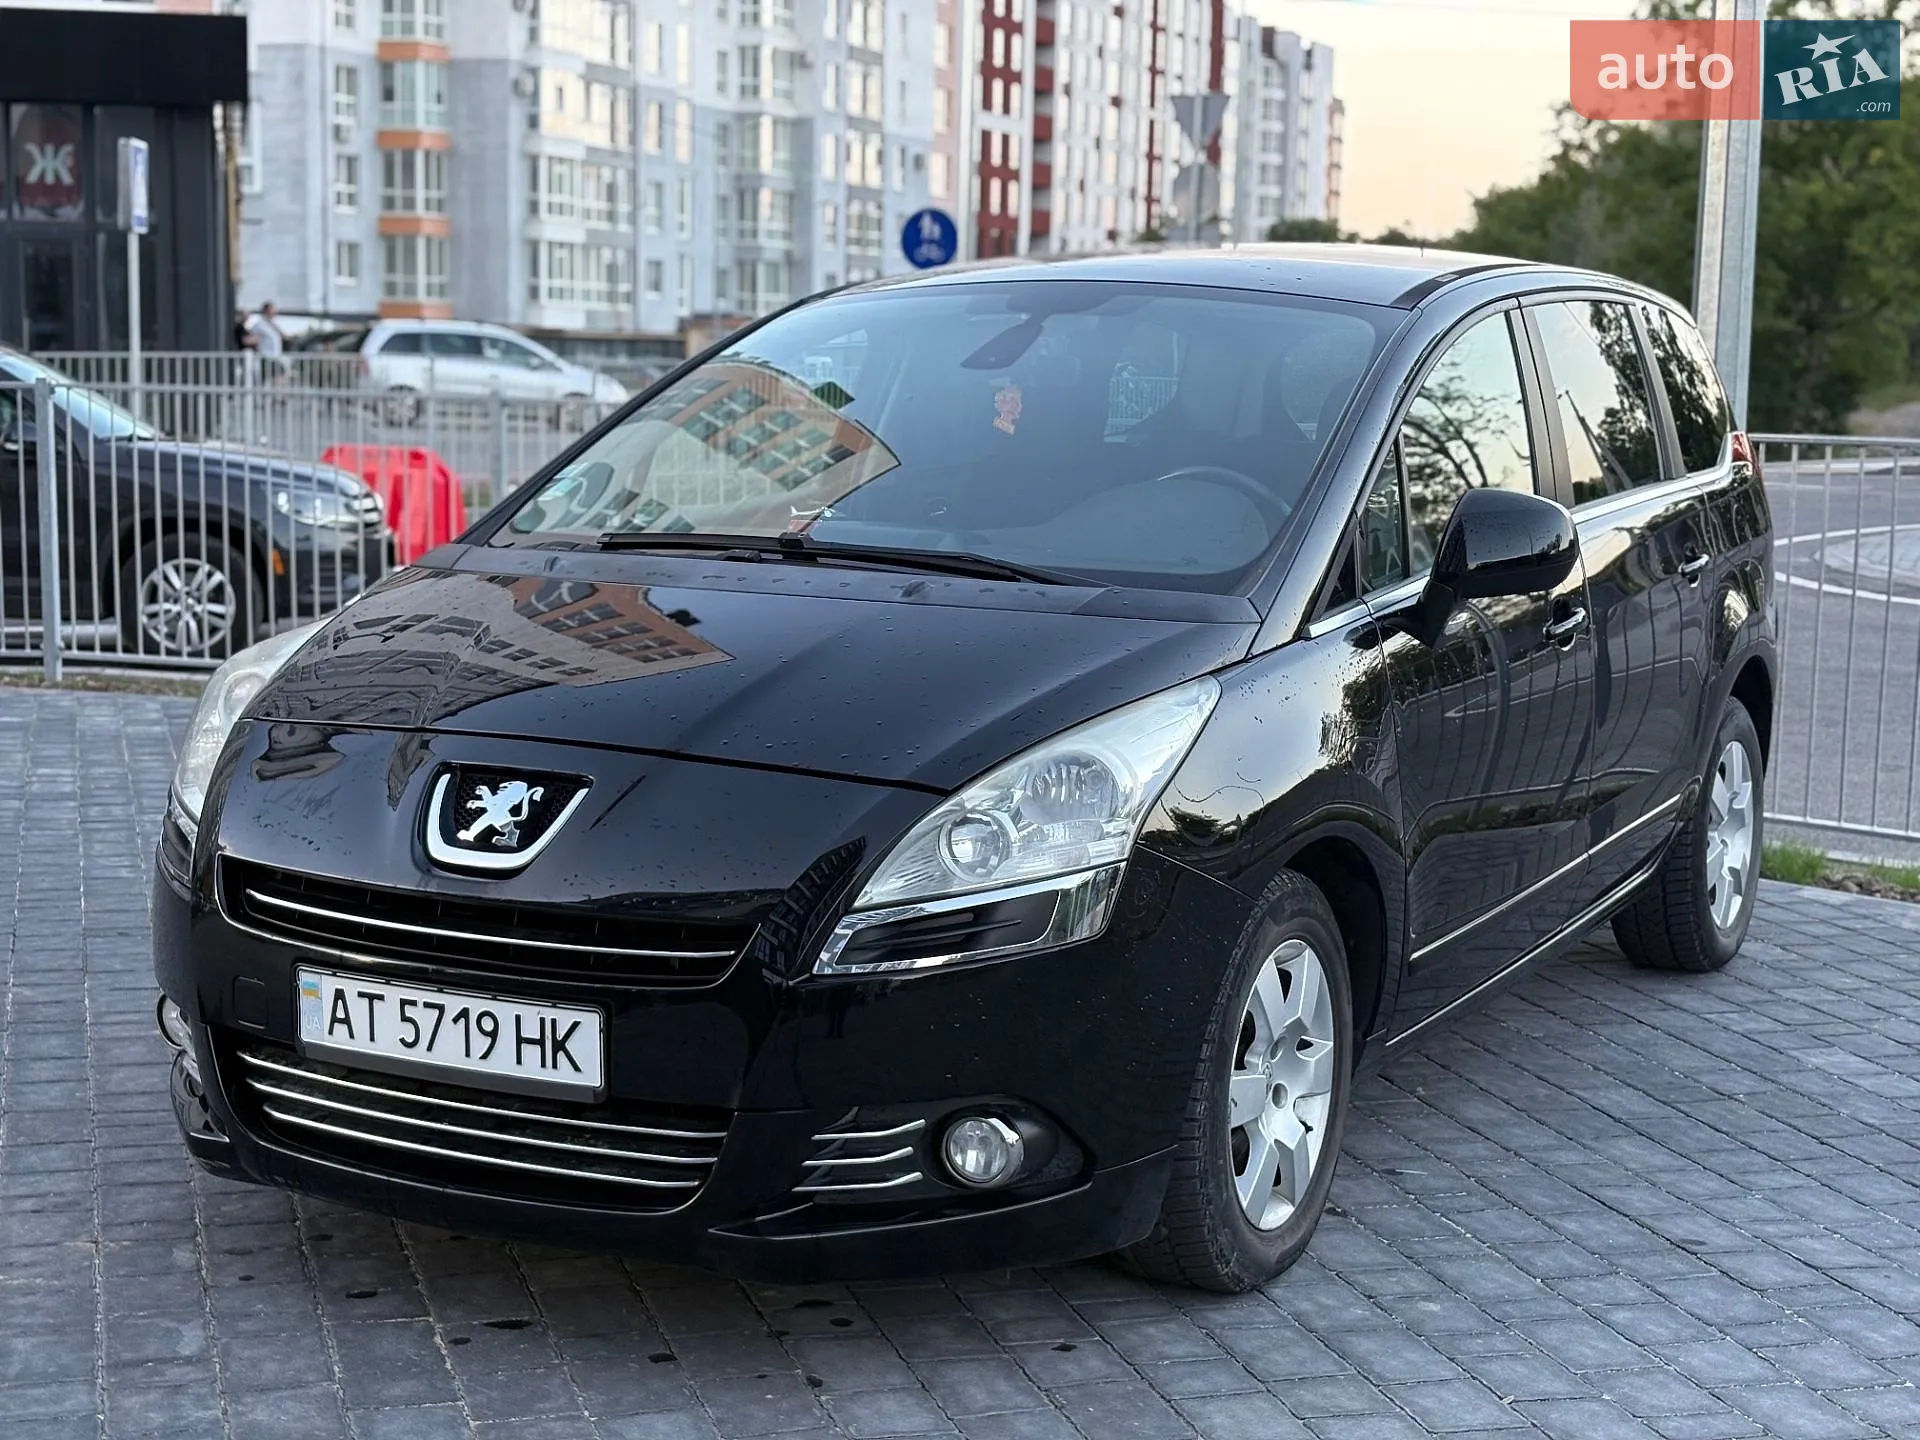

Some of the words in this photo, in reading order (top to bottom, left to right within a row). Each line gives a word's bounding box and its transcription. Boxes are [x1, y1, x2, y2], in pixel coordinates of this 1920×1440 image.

[304, 1013, 321, 1030] UA
[328, 988, 385, 1042] AT
[399, 998, 500, 1060] 5719
[514, 1013, 583, 1072] HK
